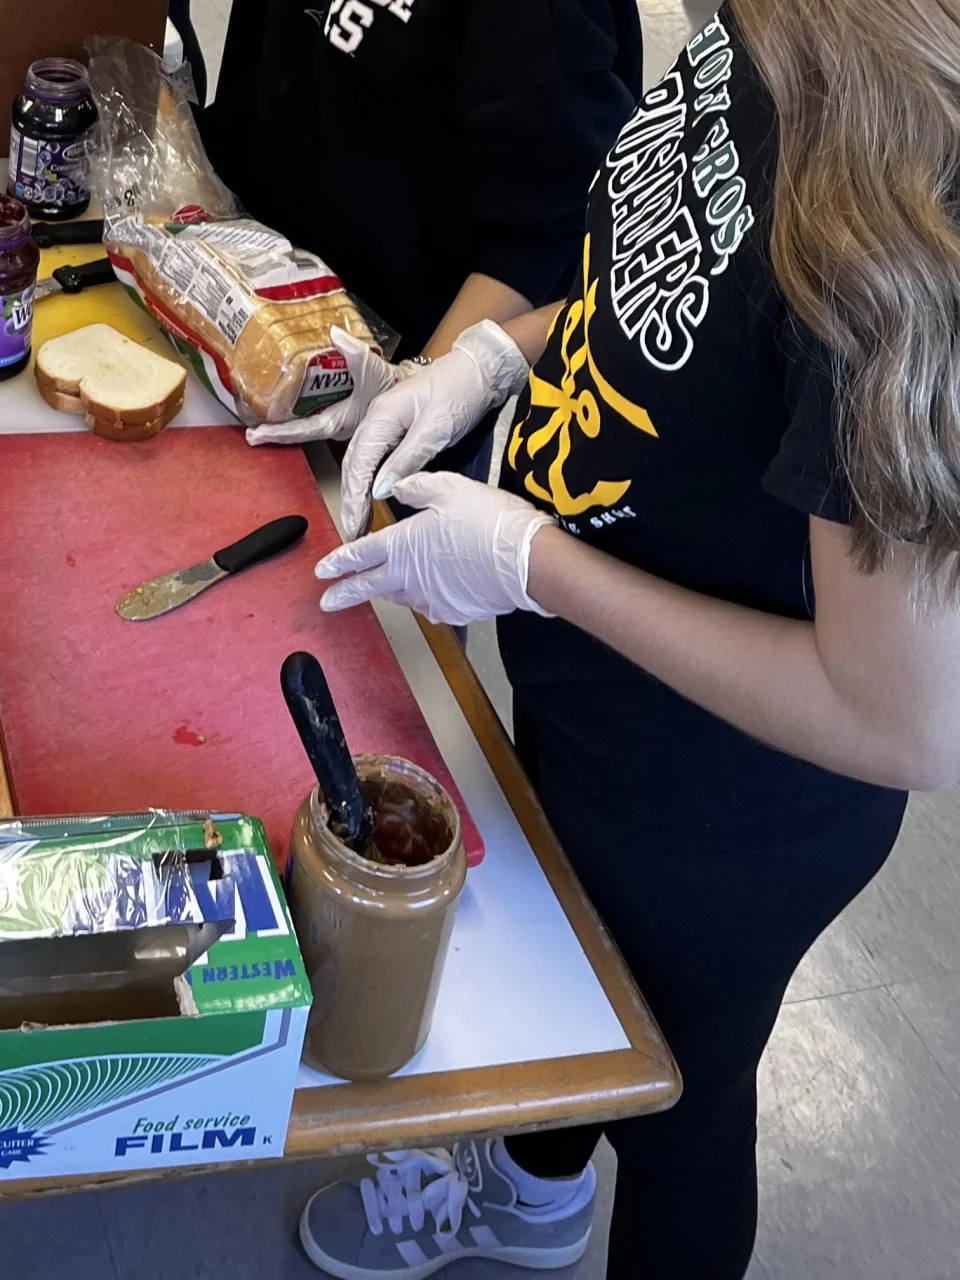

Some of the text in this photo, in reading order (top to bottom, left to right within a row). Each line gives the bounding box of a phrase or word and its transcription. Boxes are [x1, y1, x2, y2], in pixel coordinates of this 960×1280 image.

[607, 60, 710, 372] RUSADERS
[201, 958, 297, 984] WESTERN
[132, 1111, 252, 1135] Food service
[114, 1126, 258, 1158] FILM
